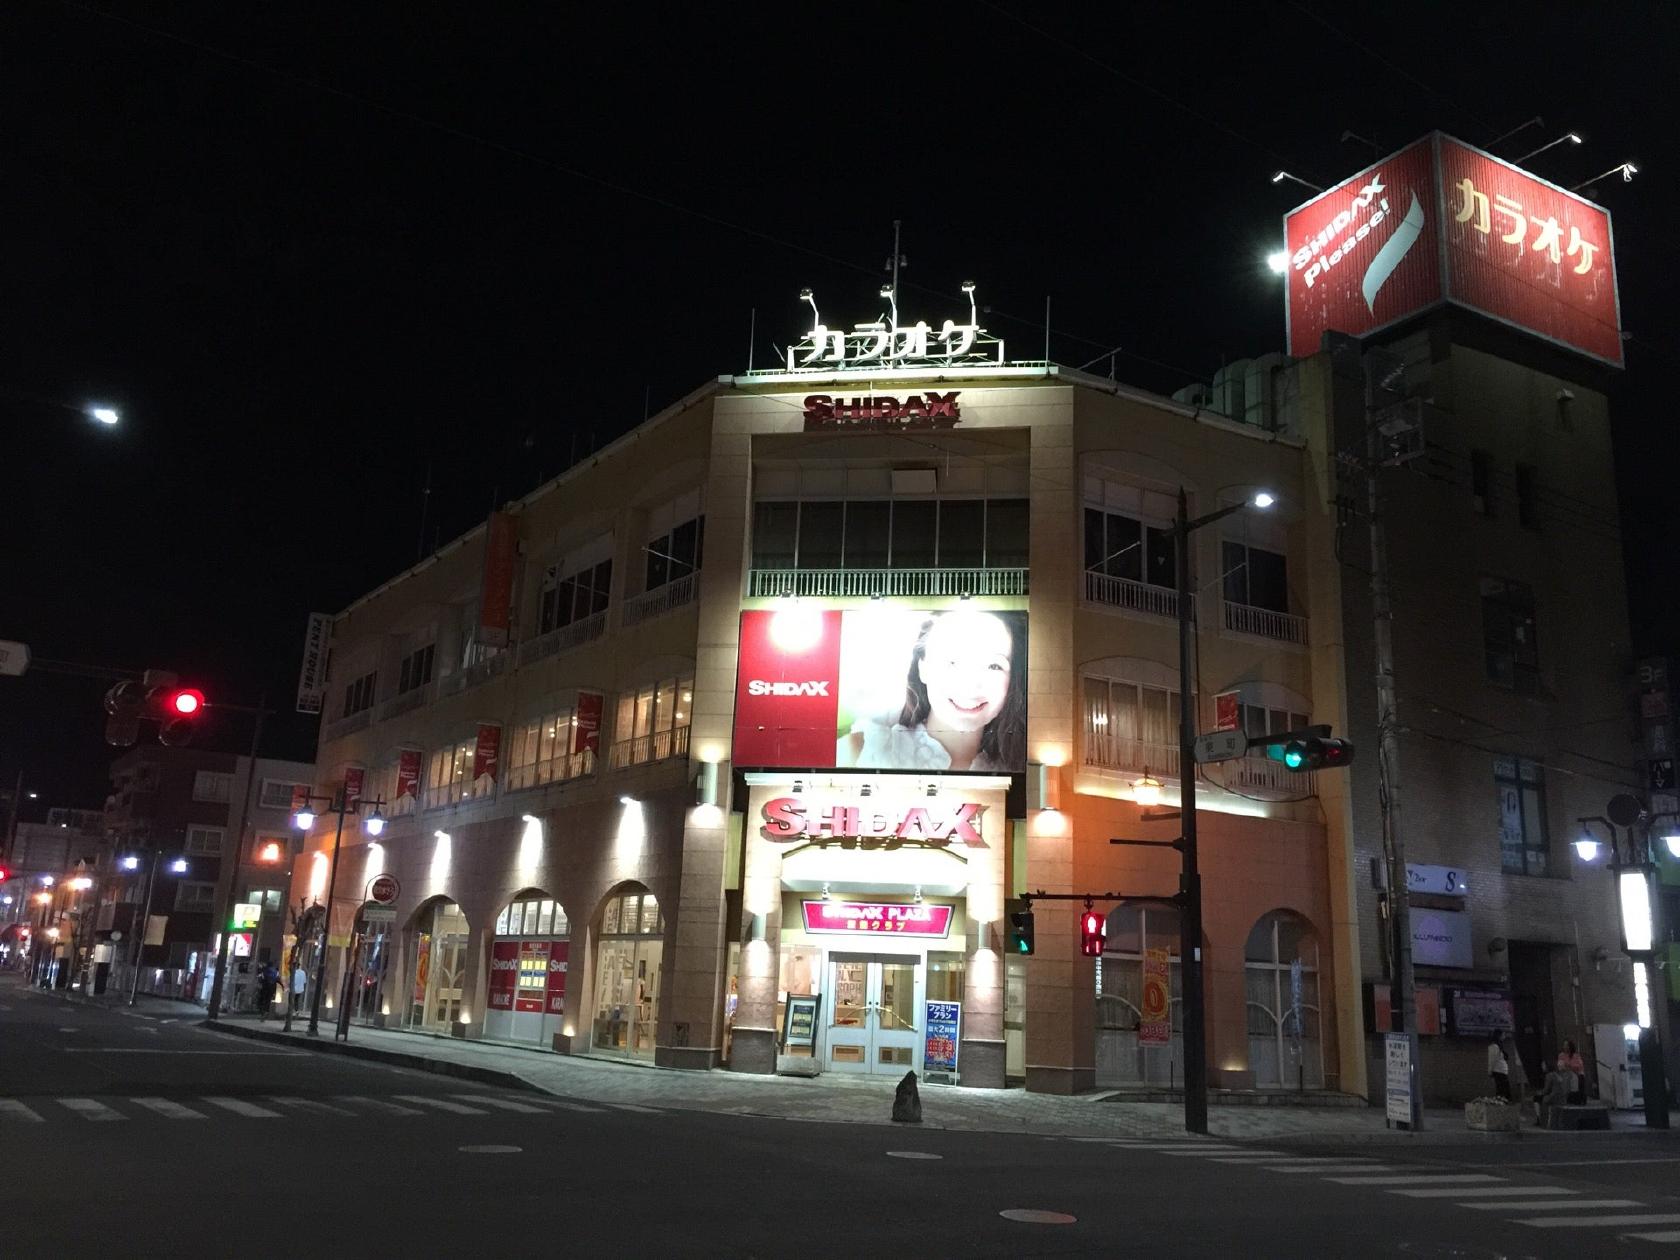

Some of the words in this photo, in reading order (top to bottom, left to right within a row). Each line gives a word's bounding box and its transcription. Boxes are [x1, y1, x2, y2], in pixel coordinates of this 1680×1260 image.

[1292, 172, 1386, 271] SHIDAX
[1455, 178, 1599, 275] カラオケ
[1303, 199, 1391, 288] Please!
[800, 320, 979, 363] カラオケ
[804, 391, 961, 421] SHIDAX
[748, 680, 829, 697] SHIDAX
[763, 797, 984, 846] SHIDAX
[888, 908, 932, 921] PLAZA
[492, 958, 518, 971] SHIDAX
[928, 1003, 958, 1013] ファミリー
